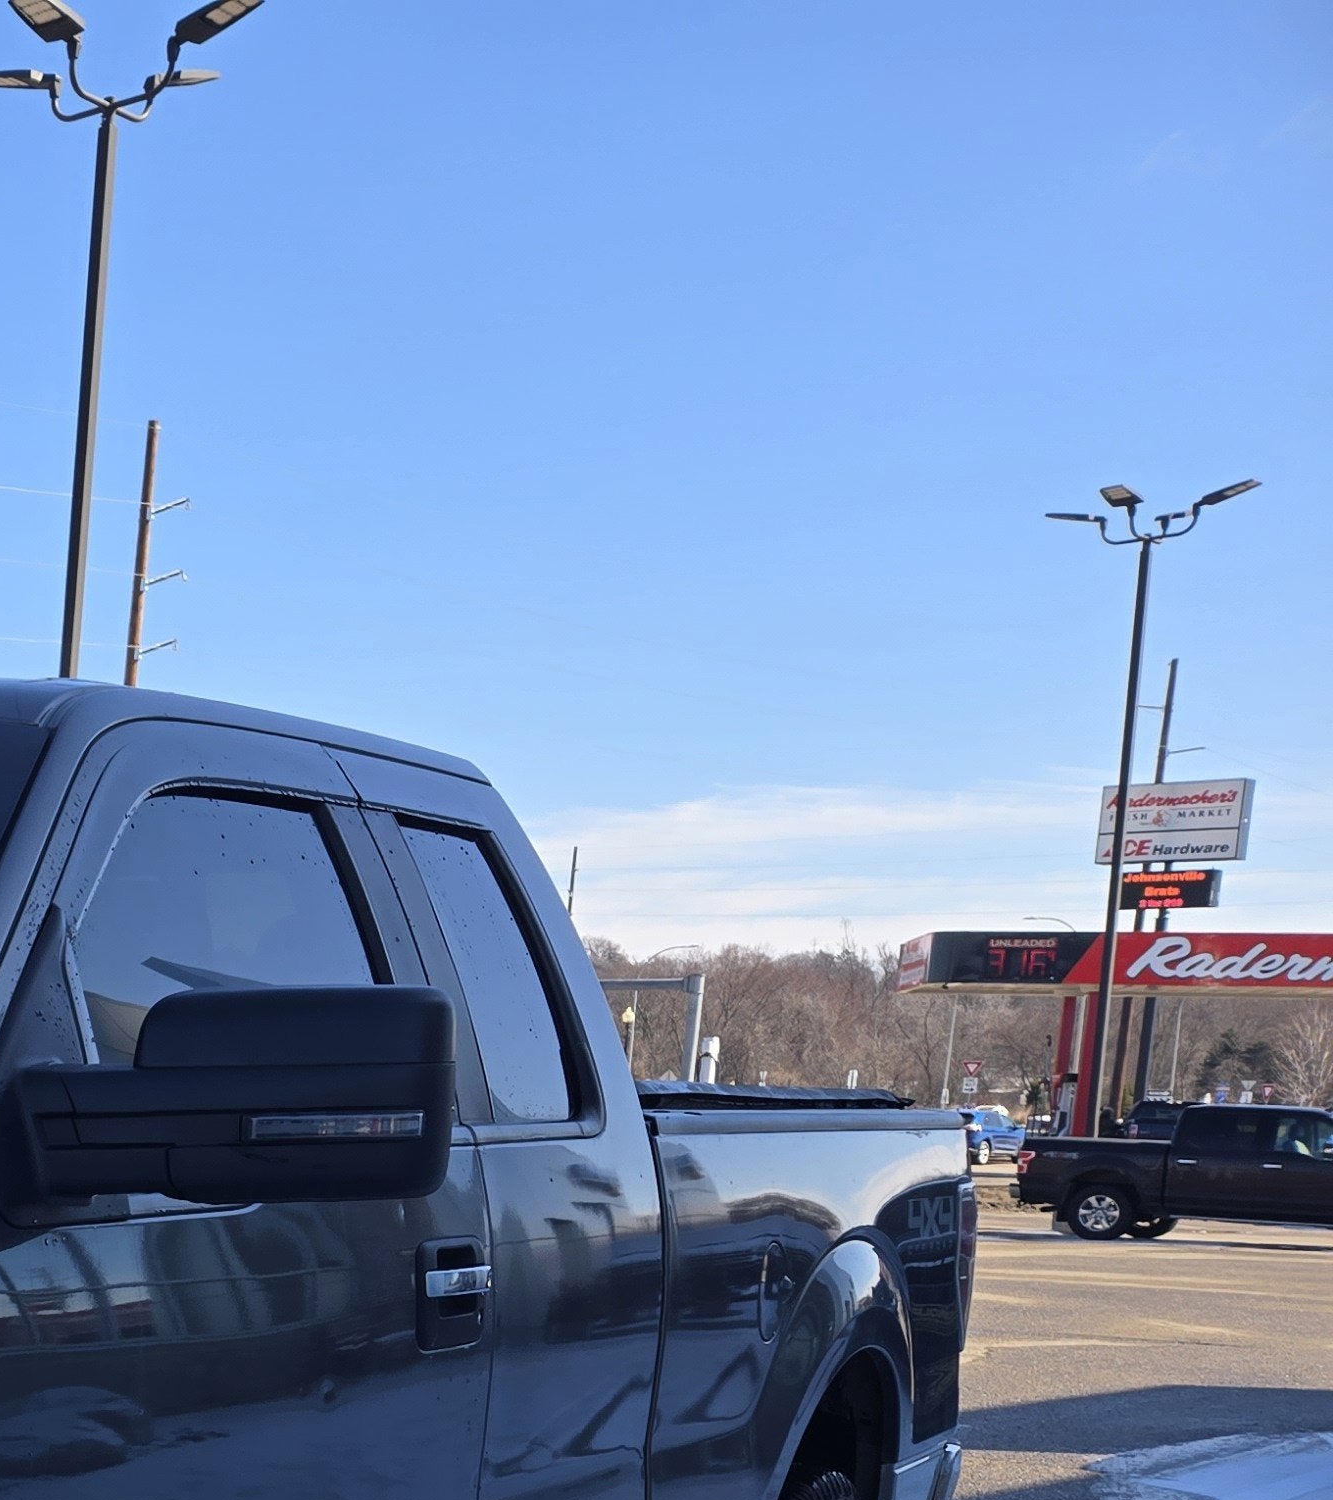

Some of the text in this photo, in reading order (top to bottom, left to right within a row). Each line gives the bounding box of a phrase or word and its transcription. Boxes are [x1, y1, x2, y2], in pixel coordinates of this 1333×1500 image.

[1177, 808, 1231, 819] MARKET
[1152, 844, 1230, 856] Hardware
[989, 938, 1056, 948] UNLEADED
